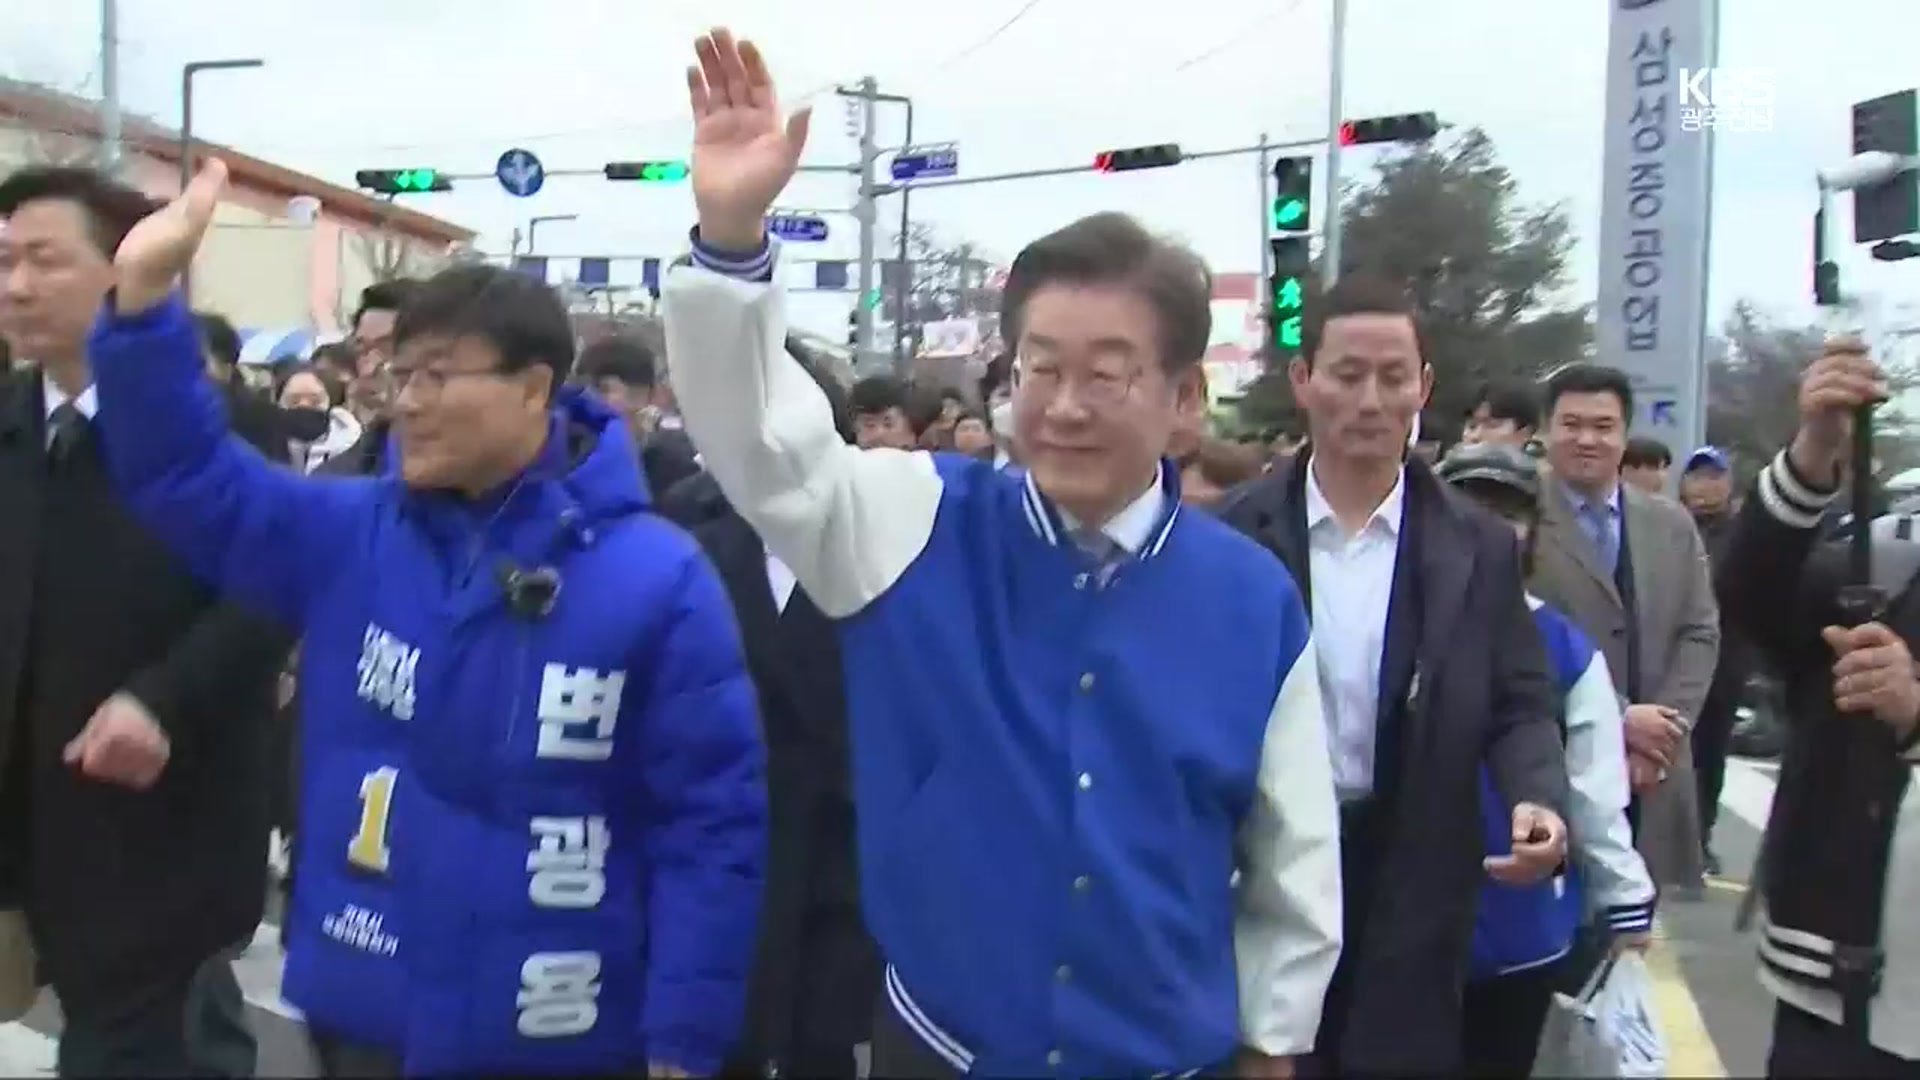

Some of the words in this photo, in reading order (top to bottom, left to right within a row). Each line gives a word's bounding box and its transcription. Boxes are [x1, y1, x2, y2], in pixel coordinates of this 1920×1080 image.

[1622, 26, 1674, 352] 삼성중공업
[348, 766, 400, 872] 1
[517, 662, 626, 1038] 변광용
